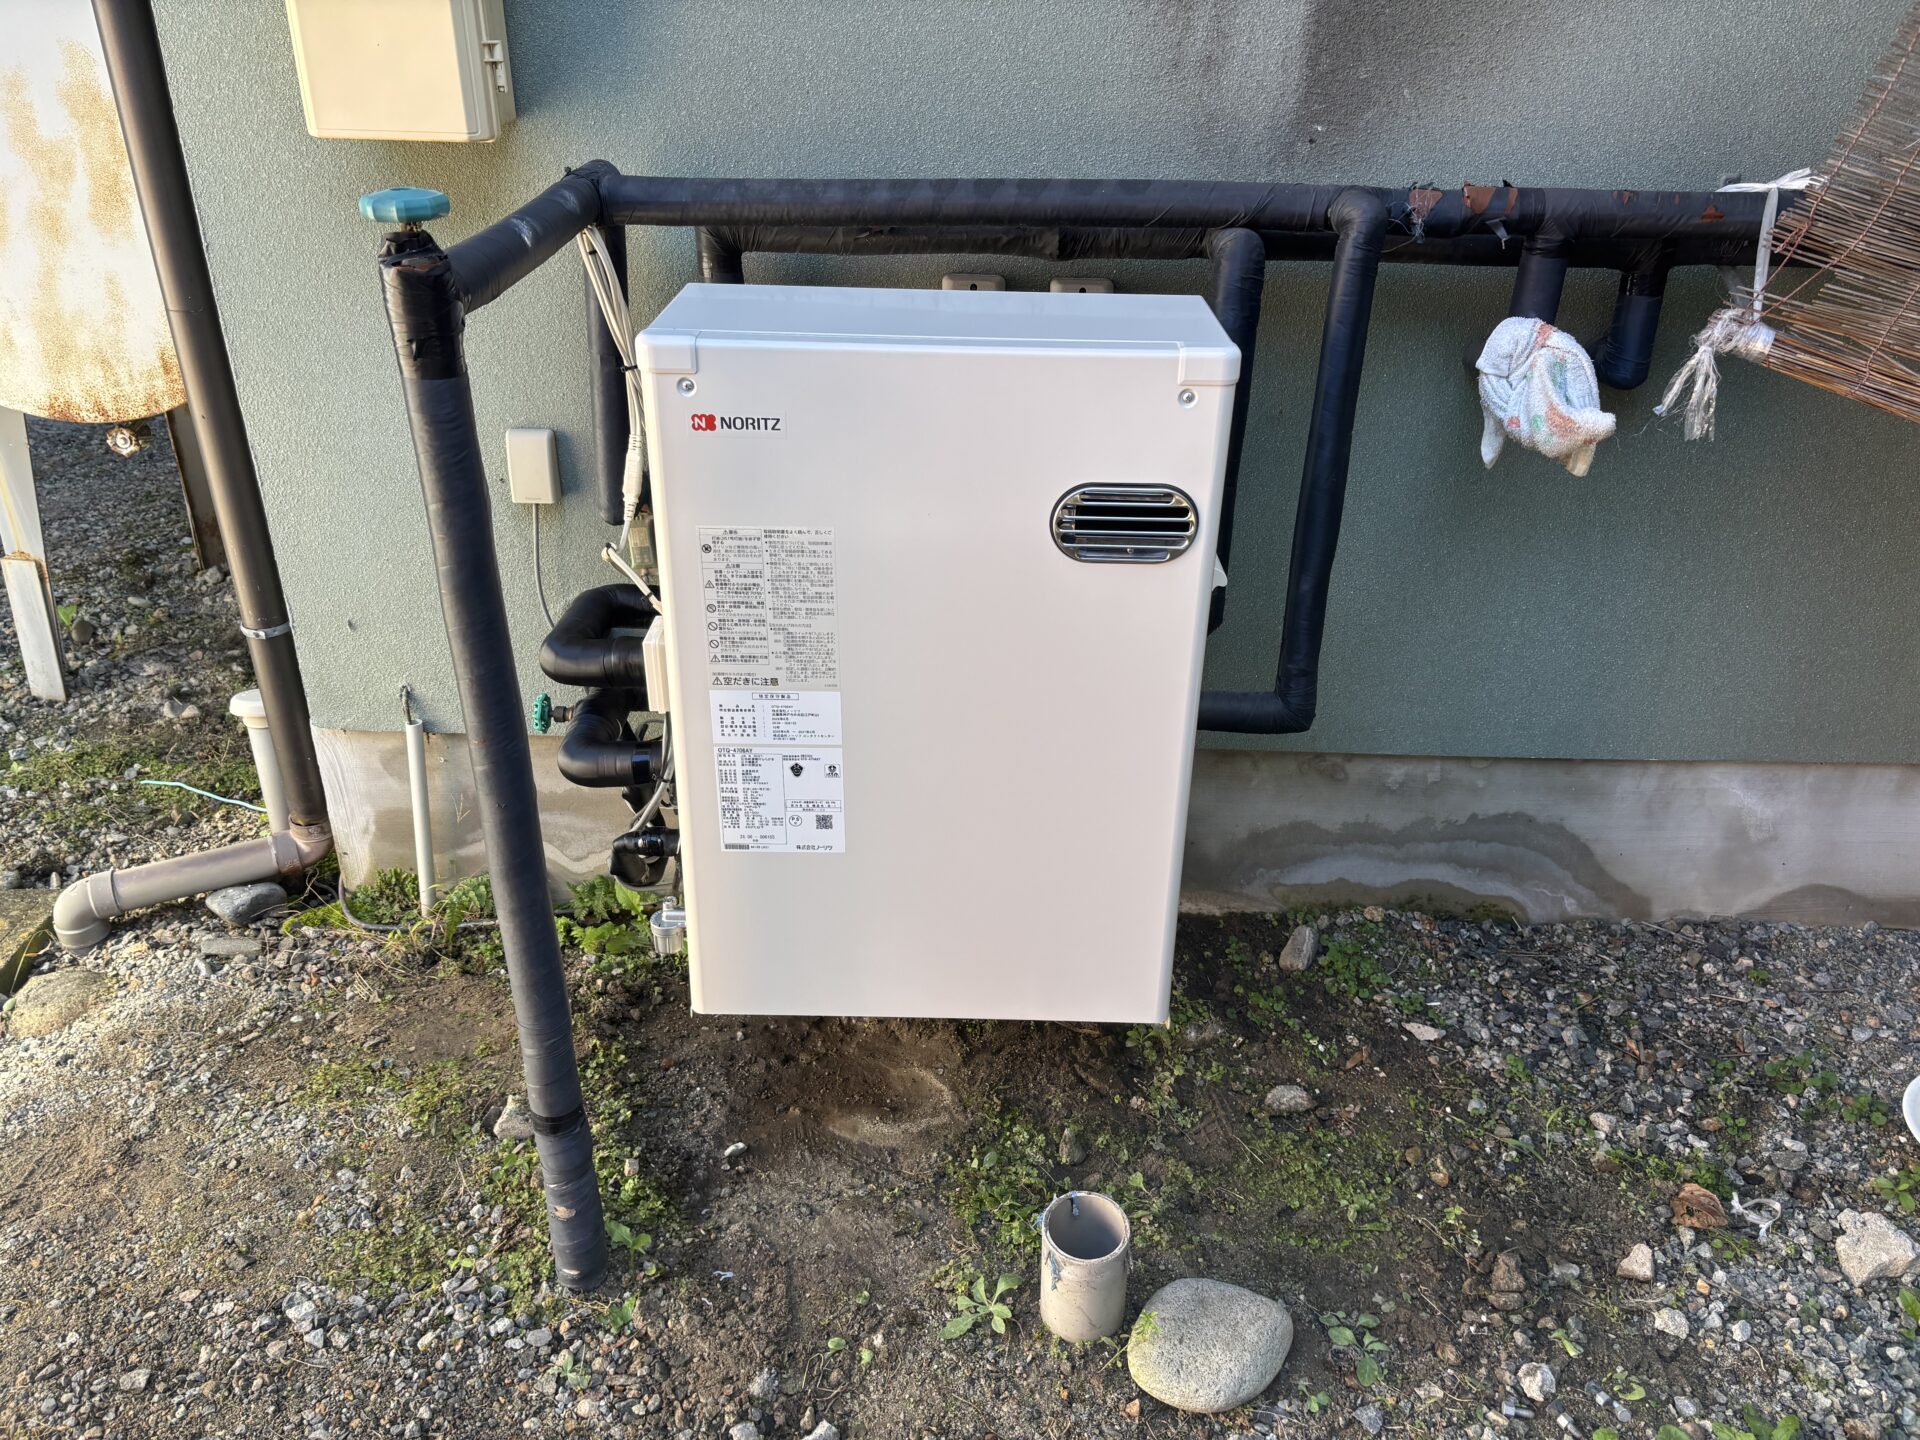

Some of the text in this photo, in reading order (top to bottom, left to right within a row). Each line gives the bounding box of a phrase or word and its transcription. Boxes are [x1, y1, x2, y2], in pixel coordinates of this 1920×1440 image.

[720, 416, 781, 431] NORITZ
[723, 676, 779, 686] 空だきに注意
